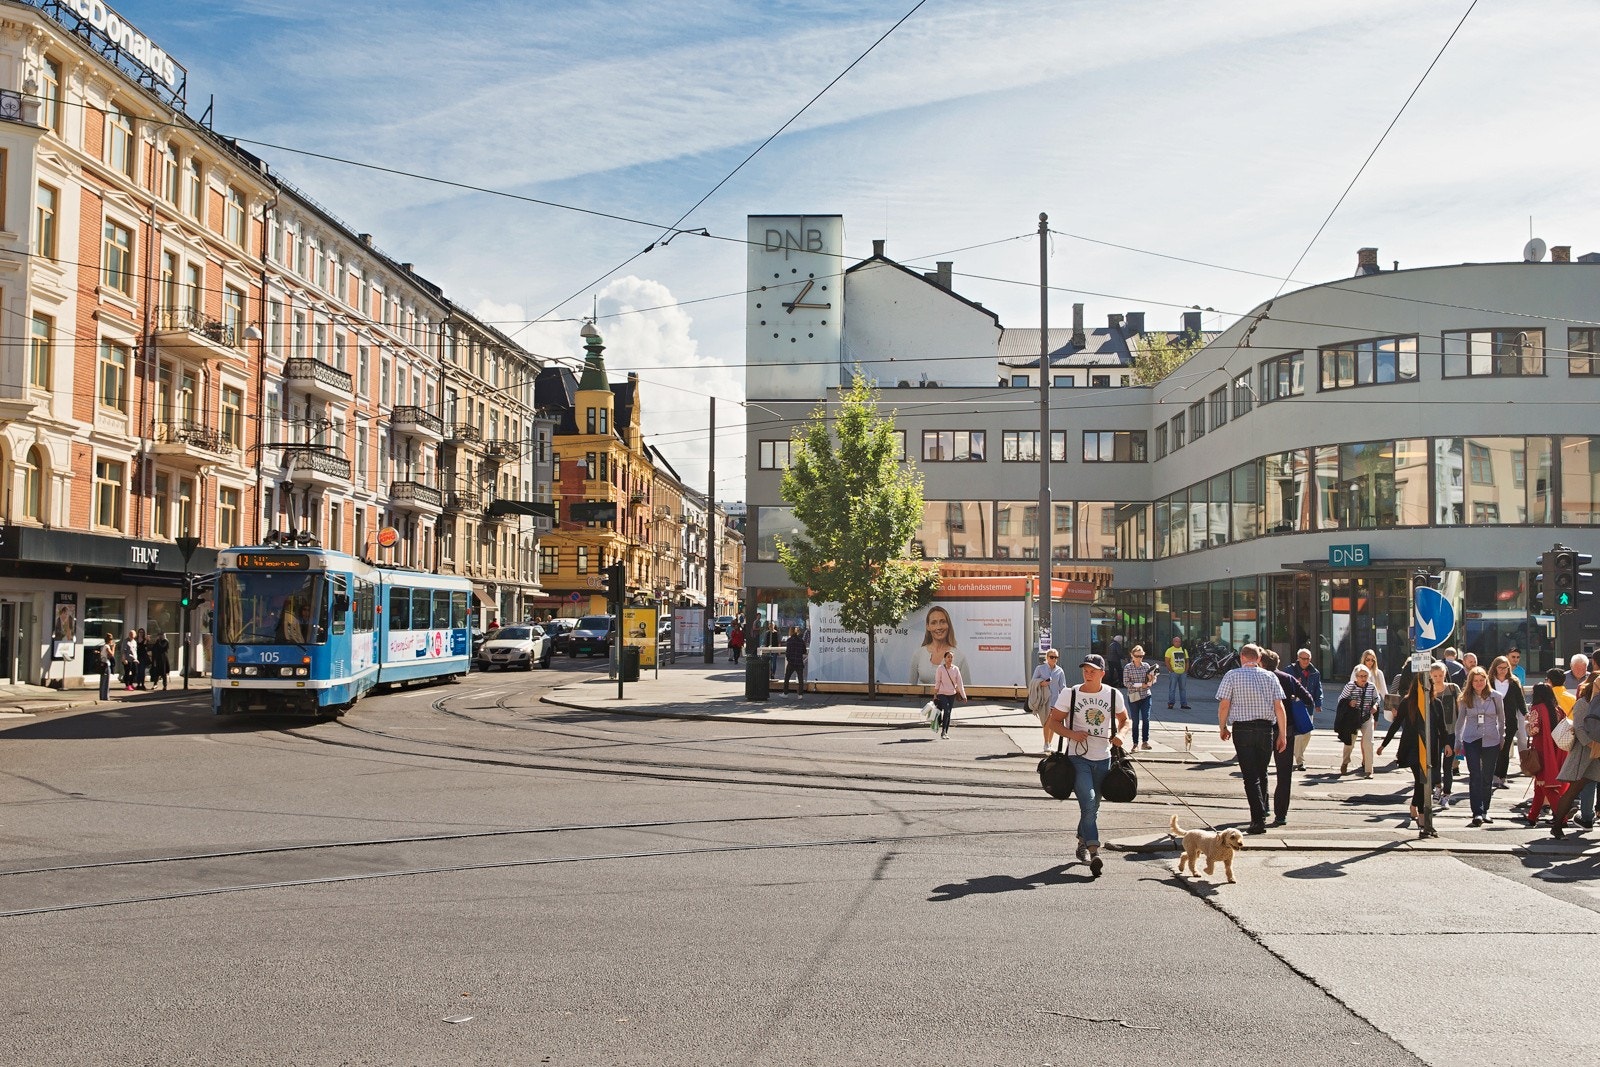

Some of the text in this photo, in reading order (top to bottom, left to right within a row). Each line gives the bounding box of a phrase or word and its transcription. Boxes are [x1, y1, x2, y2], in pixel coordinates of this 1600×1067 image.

[56, 0, 175, 86] cDonald's
[765, 218, 823, 260] DNB
[131, 546, 160, 564] THUNE
[1333, 545, 1364, 566] DNB
[947, 583, 956, 591] du
[957, 582, 1012, 591] forhåndsstemme
[894, 627, 909, 635] valg
[826, 636, 866, 645] bydelsutvalg
[259, 651, 280, 663] 105
